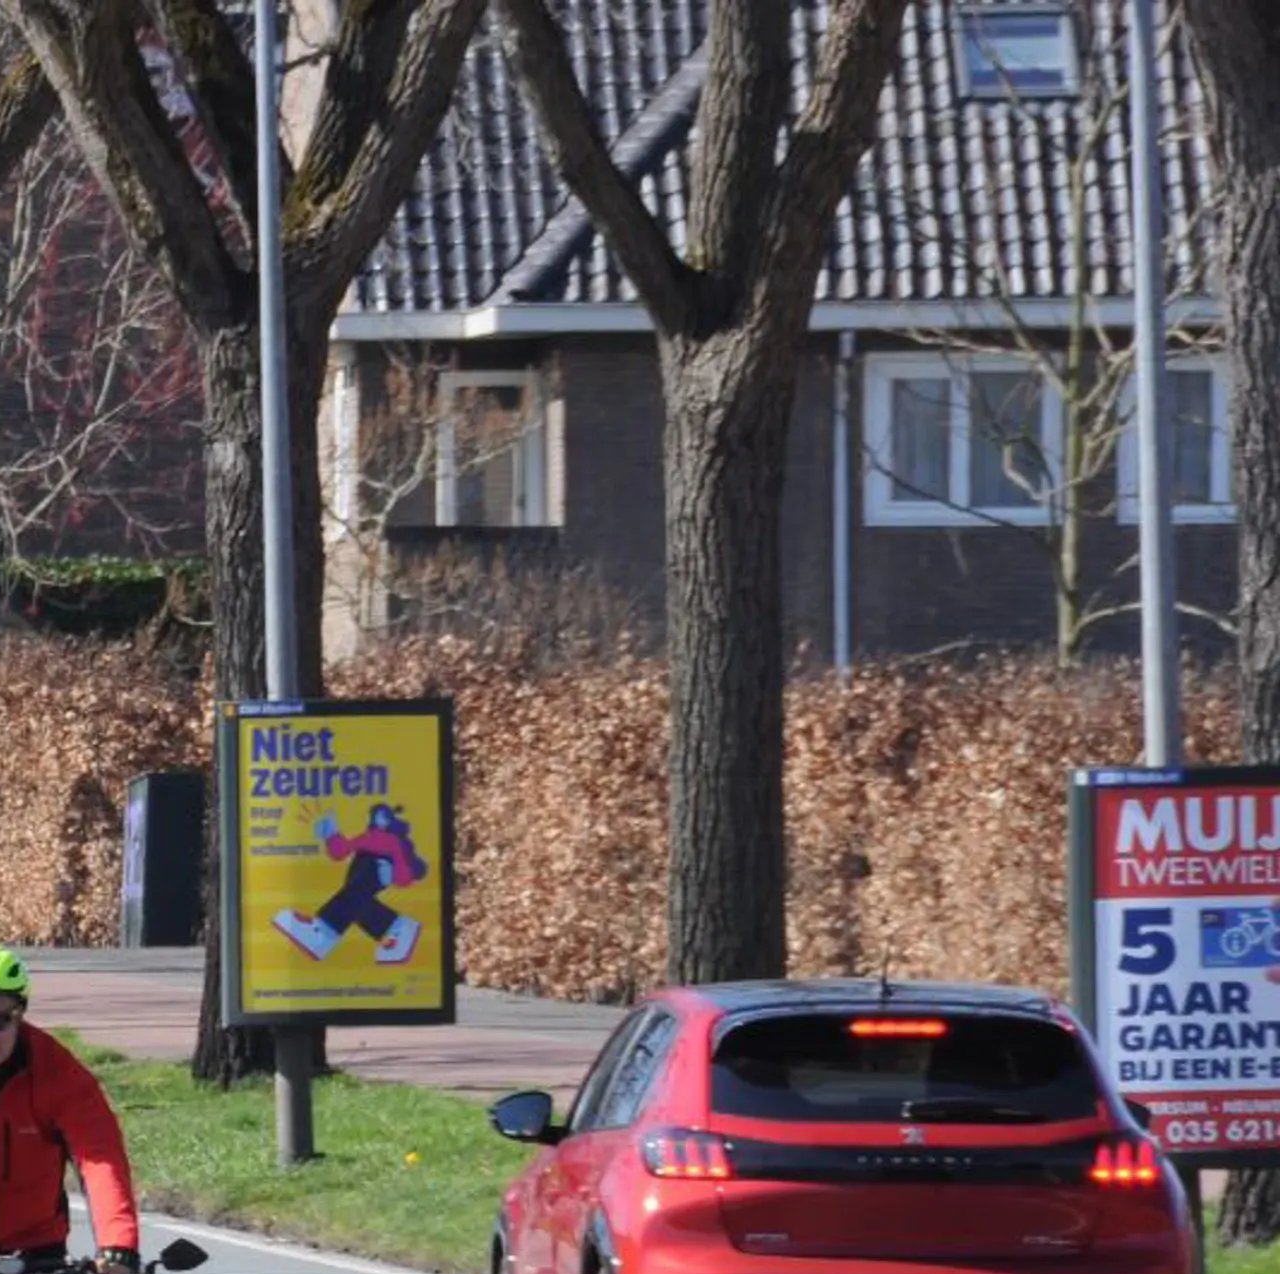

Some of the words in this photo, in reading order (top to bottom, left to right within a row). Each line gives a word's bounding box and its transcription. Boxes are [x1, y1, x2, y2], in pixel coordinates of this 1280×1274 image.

[250, 723, 335, 763] Niet
[249, 764, 389, 798] zeuren
[1115, 796, 1280, 852] MUIJ
[1113, 854, 1280, 887] TWEEWIEL
[1118, 907, 1177, 975] 5
[1117, 981, 1252, 1017] JAAR
[1118, 1060, 1163, 1082] BIJ
[1172, 1058, 1232, 1080] EEN
[1165, 1119, 1218, 1144] 035
[1226, 1118, 1280, 1142] 621
